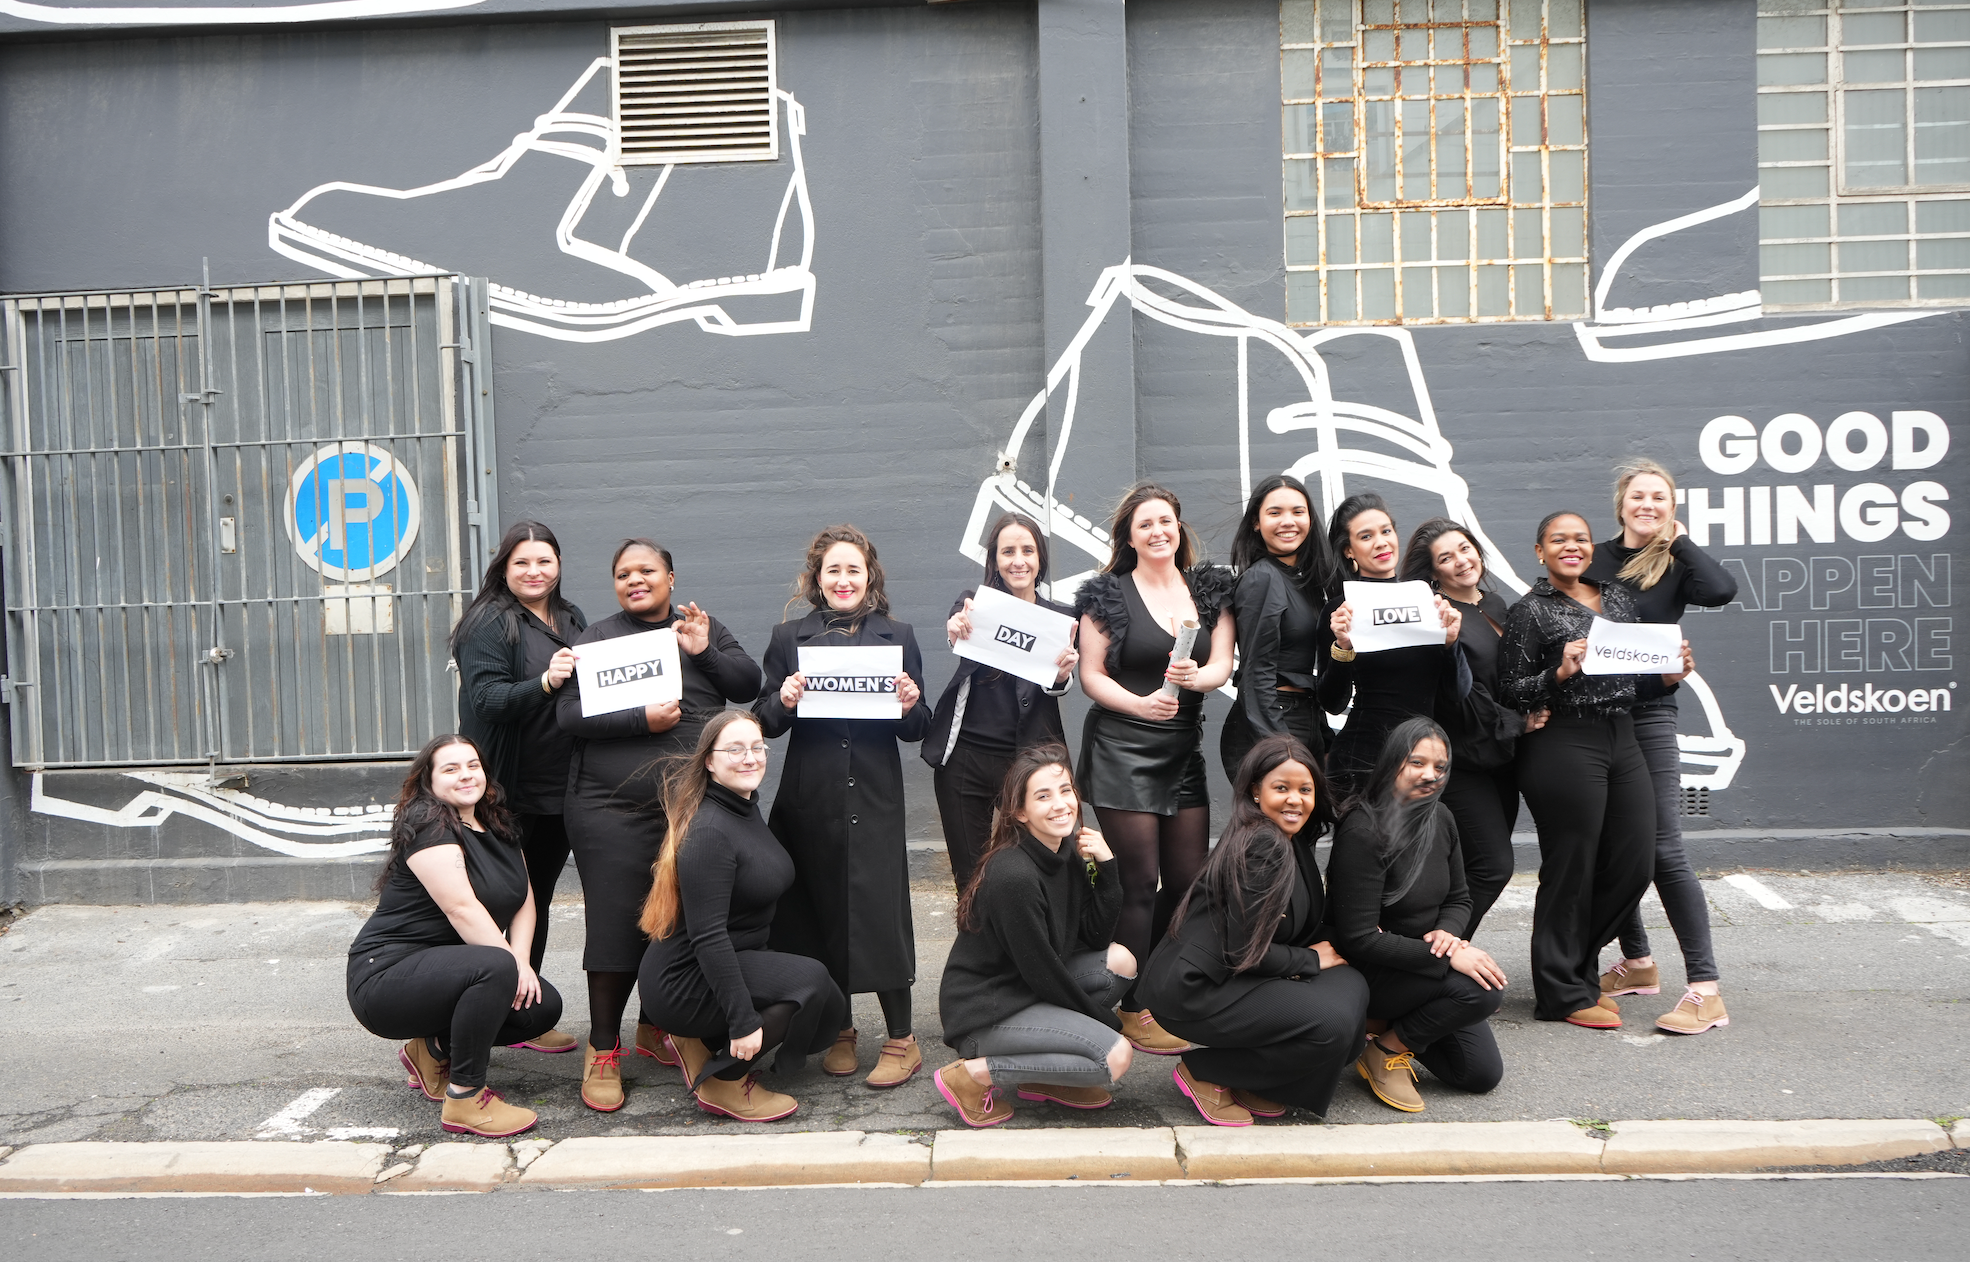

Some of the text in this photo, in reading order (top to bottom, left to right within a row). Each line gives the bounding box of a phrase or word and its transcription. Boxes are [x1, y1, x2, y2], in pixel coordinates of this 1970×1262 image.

[1699, 410, 1950, 475] GOOD
[328, 478, 385, 550] P
[1676, 481, 1951, 547] HINGS
[1684, 554, 1951, 613] APPEN
[1374, 607, 1420, 624] LOVE
[996, 626, 1033, 650] DAY
[1769, 617, 1953, 674] HERE
[1595, 645, 1669, 664] Veldskoen
[599, 660, 661, 687] HAPPY
[806, 677, 895, 692] WOMEN'S
[1817, 718, 1841, 726] SOLE
[1863, 717, 1896, 725] SOUTH
[1901, 716, 1937, 724] AFRICA
